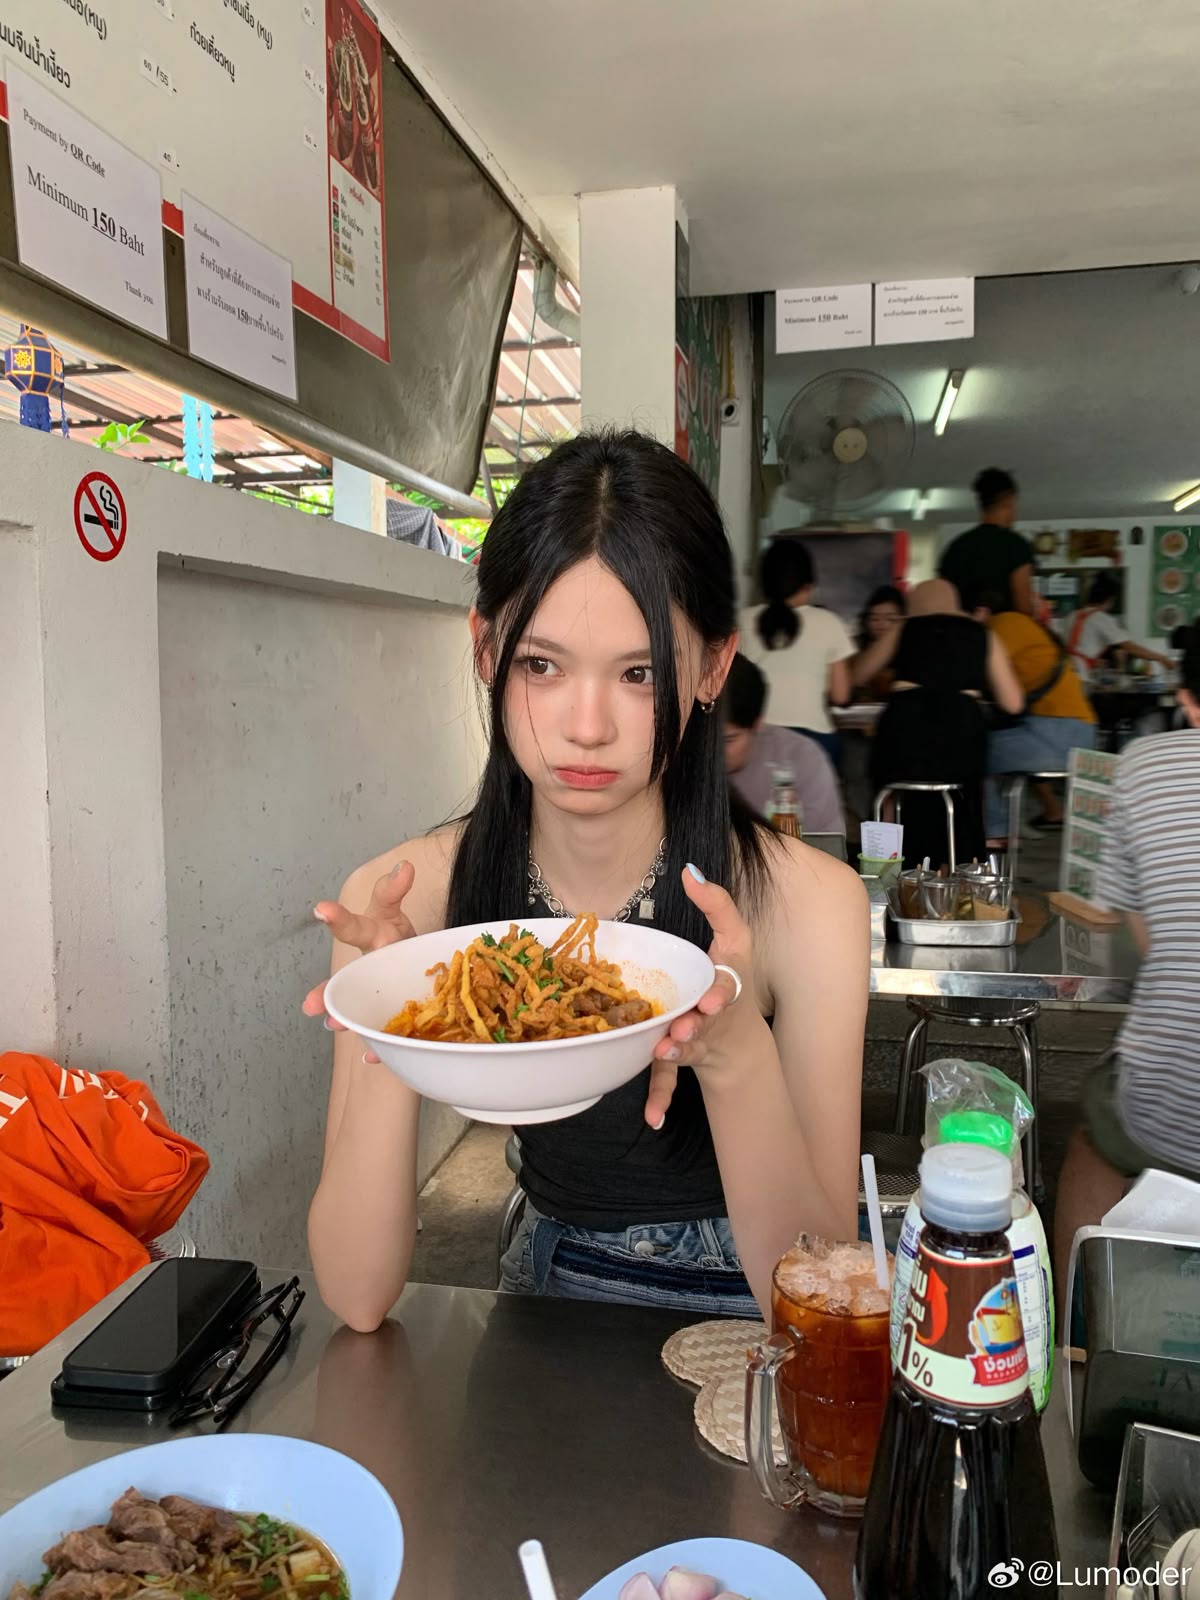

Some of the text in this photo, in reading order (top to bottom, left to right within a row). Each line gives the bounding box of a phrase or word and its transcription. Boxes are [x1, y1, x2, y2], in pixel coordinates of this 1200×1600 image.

[23, 108, 106, 178] Payment by QR Code
[27, 165, 145, 256] Minimum 150 Baht
[124, 280, 142, 298] Thank
